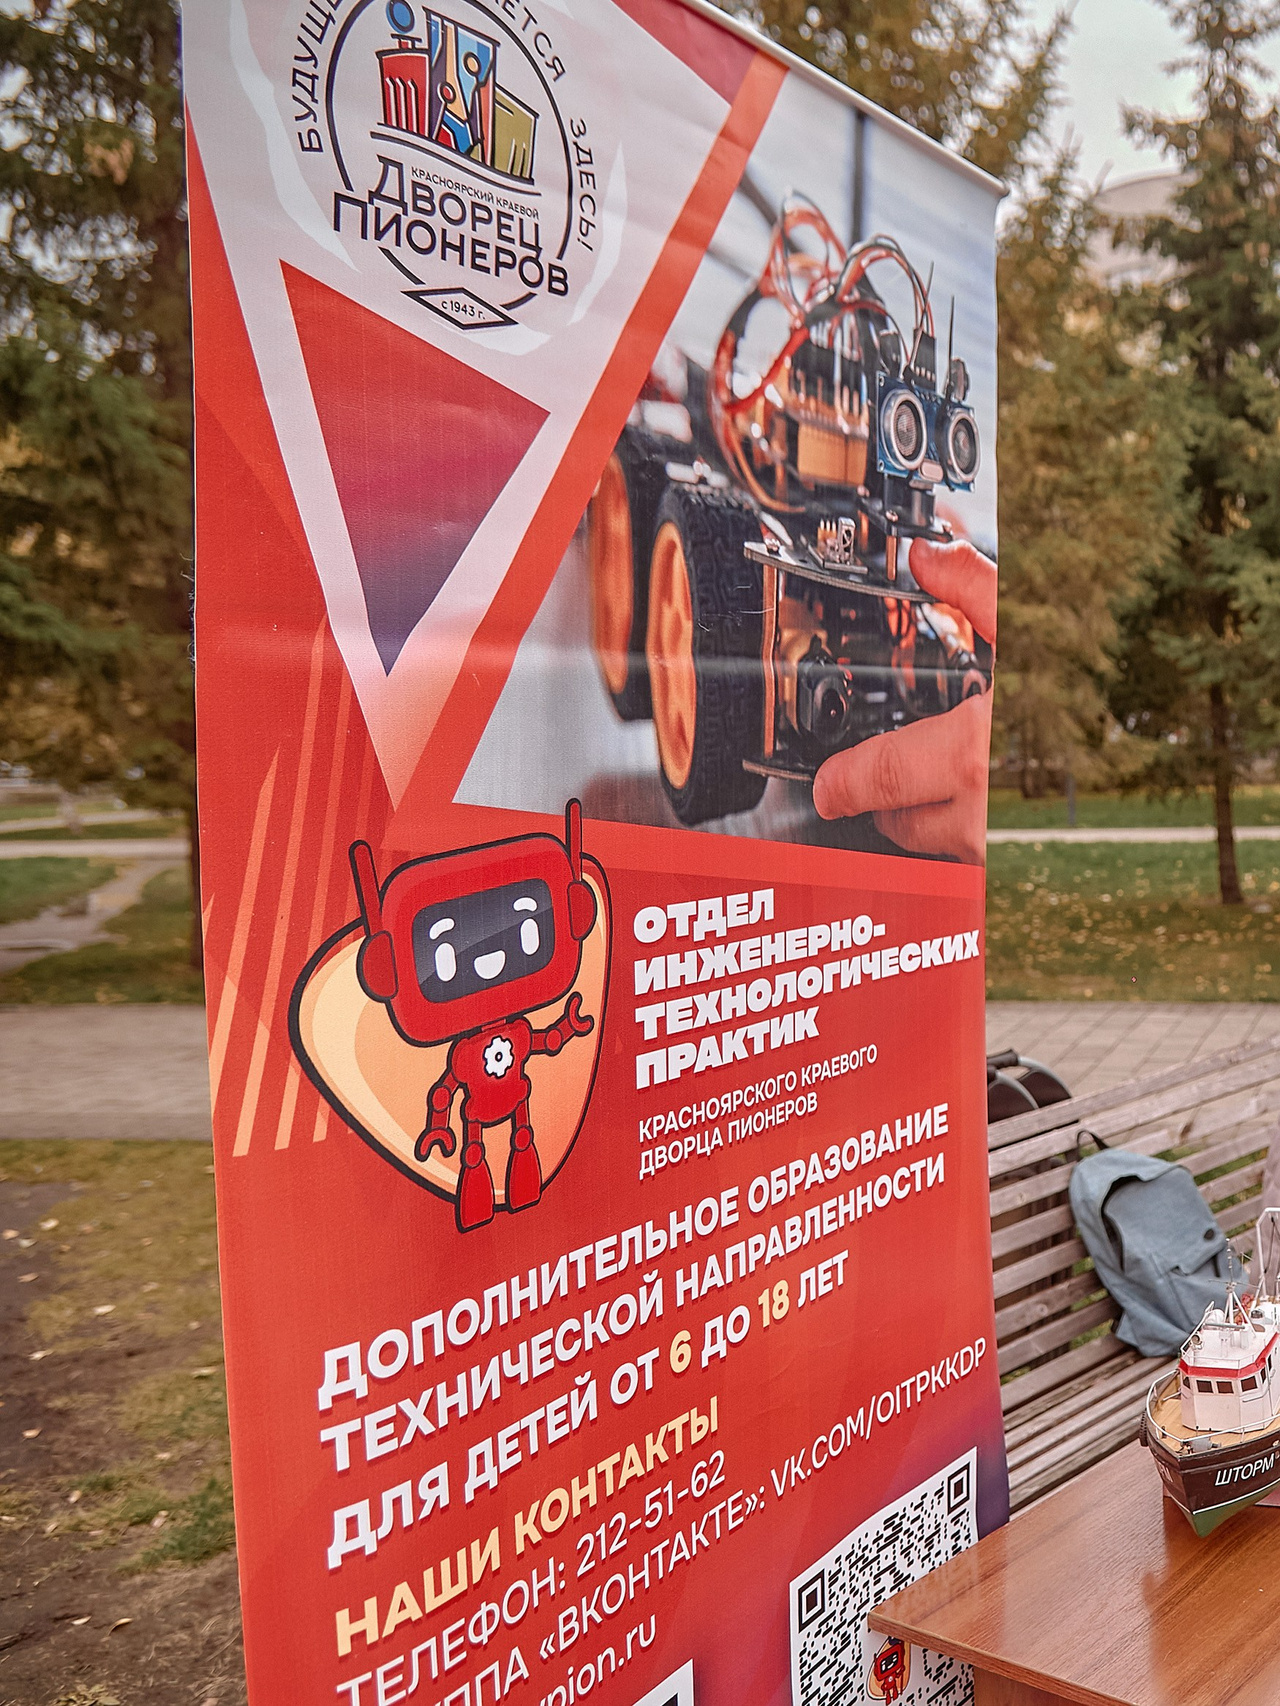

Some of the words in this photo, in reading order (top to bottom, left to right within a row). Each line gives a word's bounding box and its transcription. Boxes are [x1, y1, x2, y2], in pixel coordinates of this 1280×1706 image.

[291, 0, 342, 153] БУДУЩ
[494, 0, 566, 82] ЕТСЯ
[368, 154, 543, 260] ДВОРЕЦ
[411, 166, 495, 204] КРАСНОЯРСКИЙ
[496, 197, 540, 220] КРАЕВОЙ
[569, 118, 597, 252] ЗДЕСЬ!
[333, 191, 569, 297] ПИОНЕРОВ
[450, 300, 475, 317] 1943
[478, 311, 486, 320] г.
[633, 888, 775, 943] ОТДЕЛ
[634, 914, 886, 995] ИНЖЕНЕРНО-
[635, 930, 980, 1040] ТЕХНОЛОГИЧЕСКИХ
[636, 1006, 820, 1090] ПРАКТИК
[639, 1070, 797, 1143] КРАСНОЯРСКОГО
[801, 1044, 878, 1088] КРАЕВОГО
[639, 1126, 724, 1180] ДВОРЦА
[728, 1092, 818, 1144] ПИОНЕРОВ
[318, 1185, 740, 1411] ДОПОЛНИТЕЛЬНОЕ
[747, 1103, 949, 1221] ОБРАЗОВАНИЕ
[320, 1276, 664, 1472] ТЕХНИЧЕСКОЙ
[675, 1153, 945, 1307] НАПРАВЛЕННОСТИ
[327, 1461, 450, 1569] ДЛЯ
[464, 1366, 598, 1498] ДЕТЕЙ
[610, 1346, 660, 1405] ОТ
[669, 1330, 692, 1374] 6
[700, 1305, 750, 1370] ДО
[757, 1279, 789, 1330] 18
[797, 1250, 849, 1309] ЛЕТ
[539, 1483, 765, 1661] «ВКОНТАКТЕ»:
[771, 1336, 986, 1497] VK.COM/OITPKKDP
[1215, 1453, 1275, 1486] ШТОРМ
[335, 1526, 501, 1657] НАШИ
[512, 1397, 719, 1555] КОНТАКТЫ
[336, 1557, 566, 1706] ТЕЛЕФОН:
[576, 1450, 726, 1578] 212-51-62
